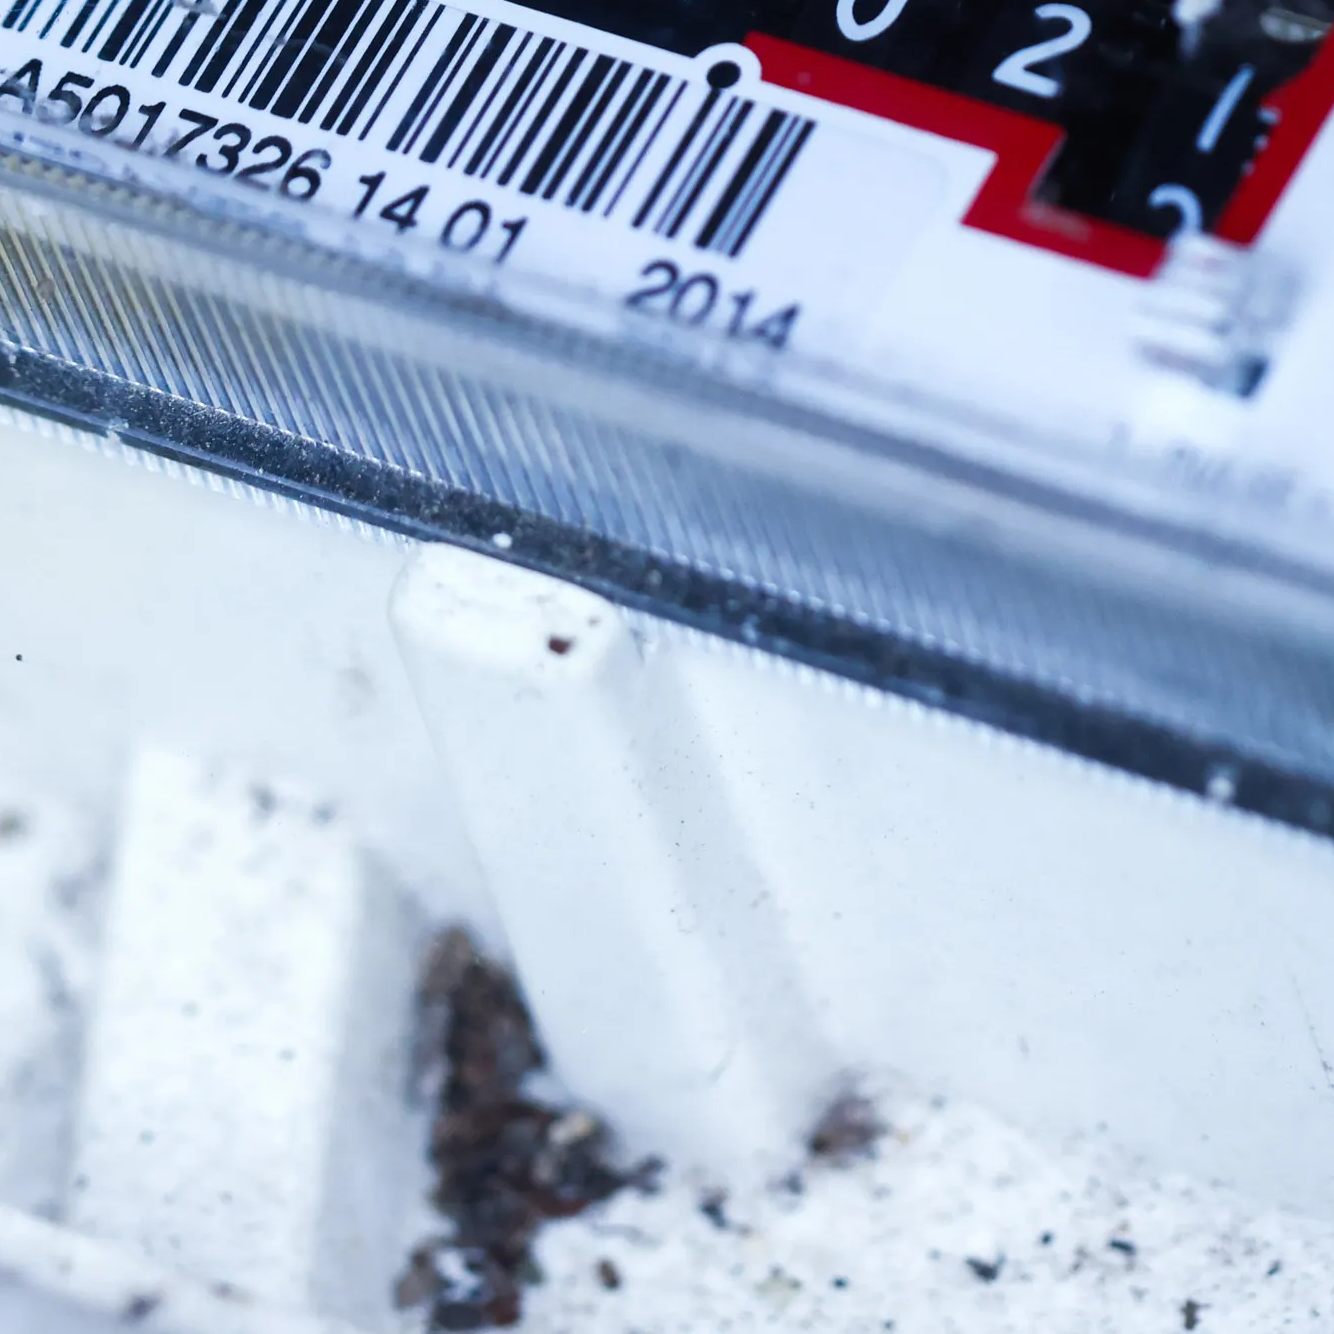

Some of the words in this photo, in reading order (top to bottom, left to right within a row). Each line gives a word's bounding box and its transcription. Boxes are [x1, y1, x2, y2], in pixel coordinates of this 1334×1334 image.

[358, 170, 431, 234] 14
[441, 199, 529, 266] 01
[624, 259, 801, 351] 2014
